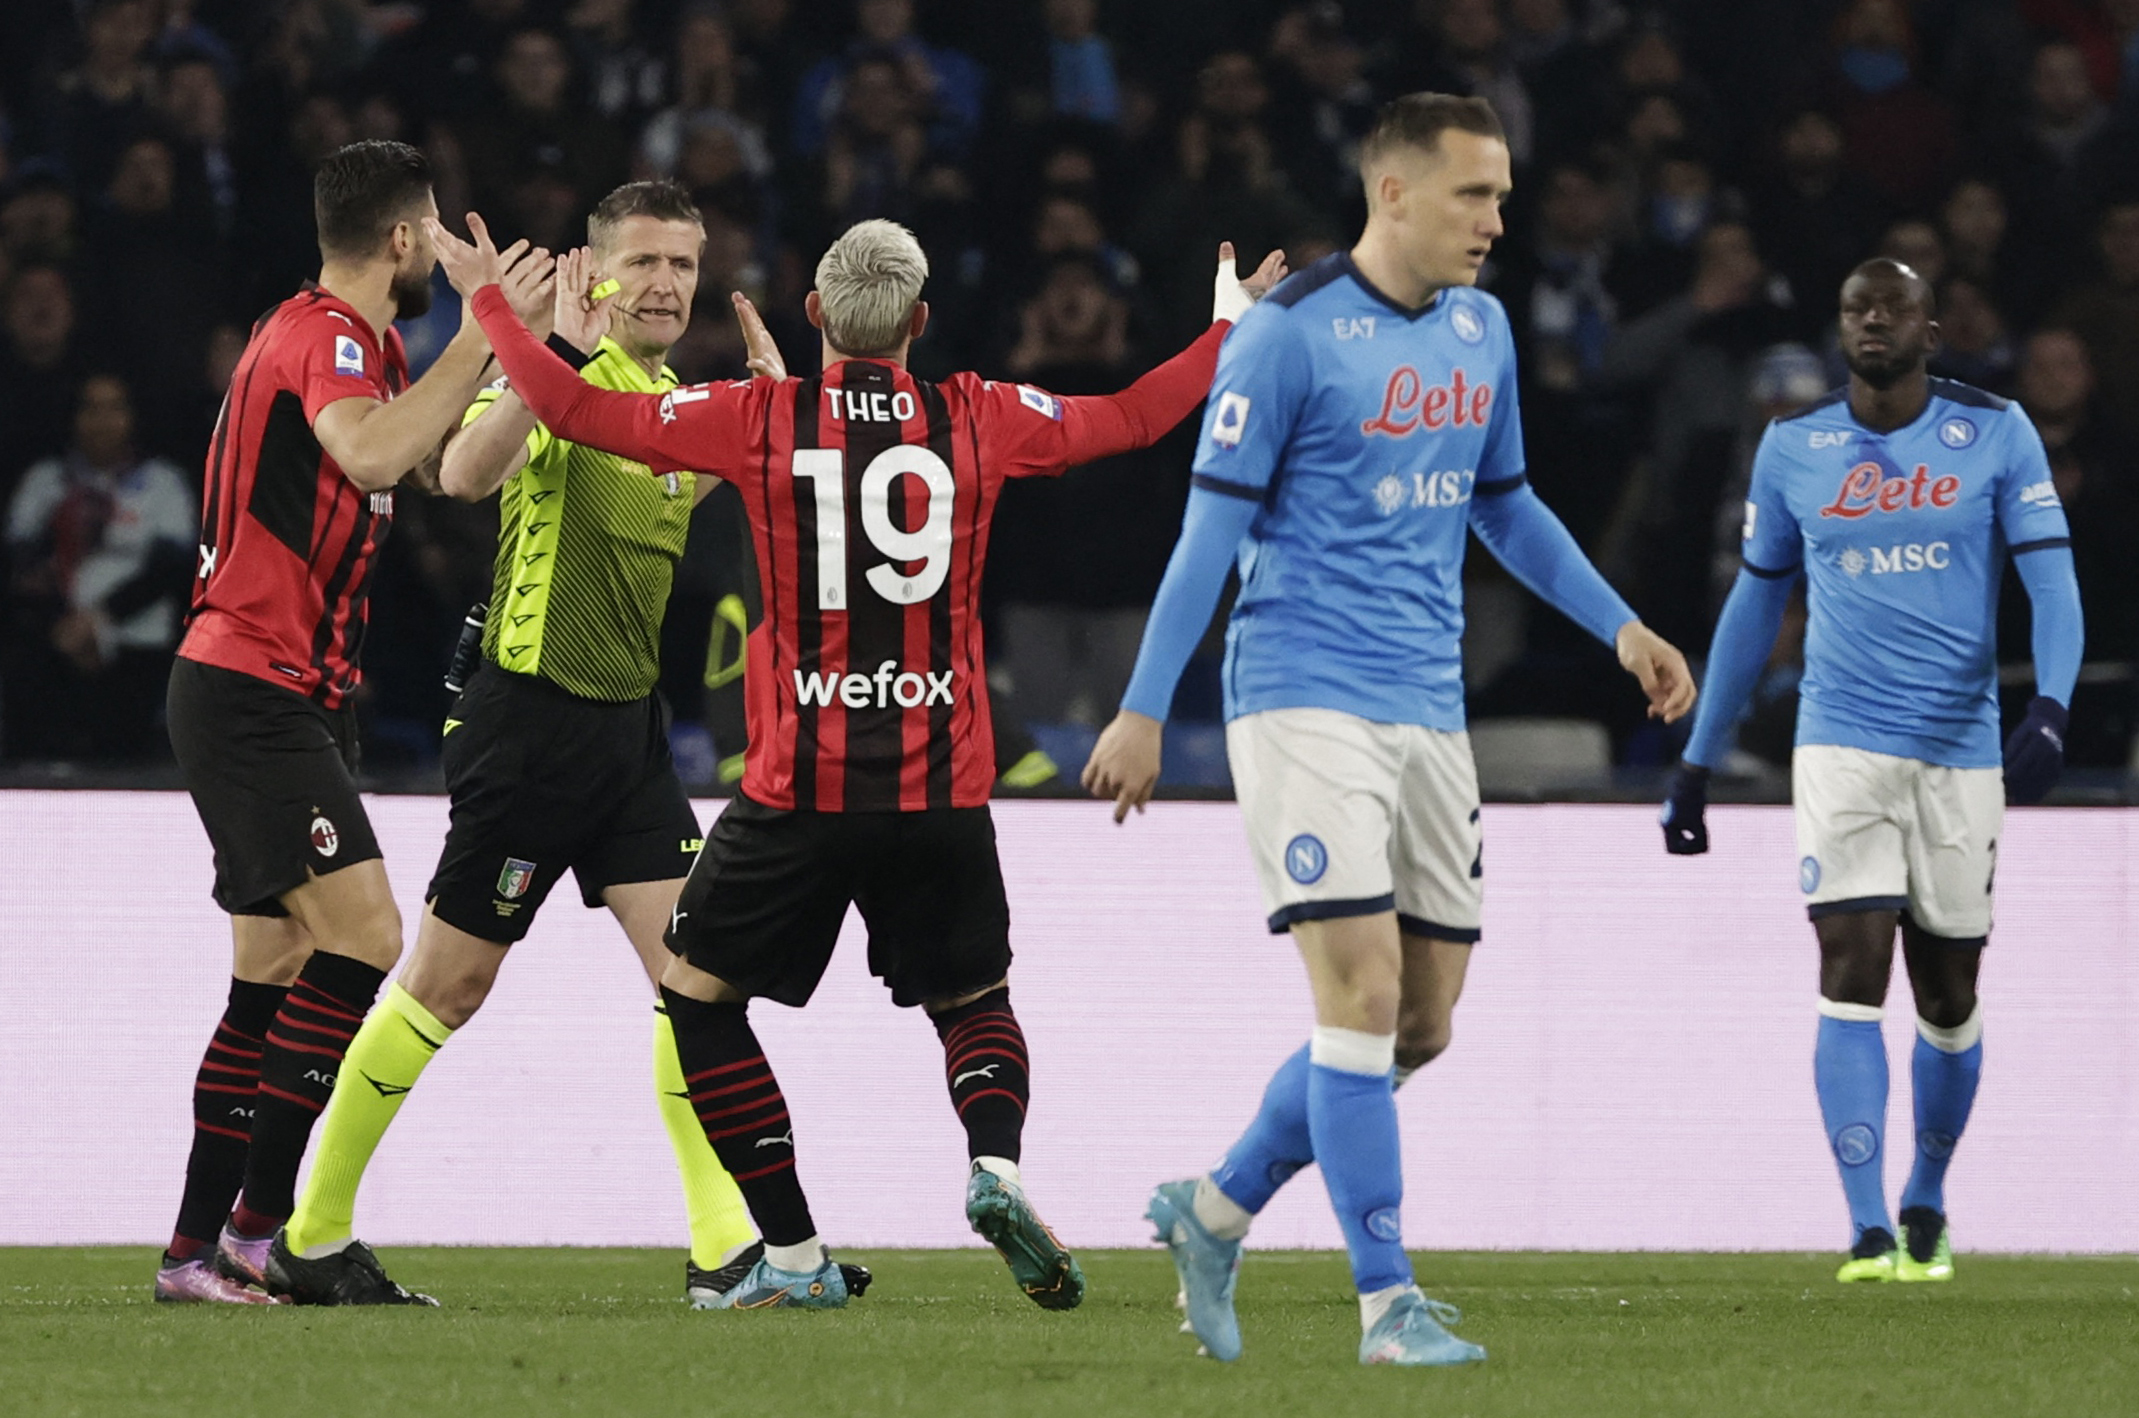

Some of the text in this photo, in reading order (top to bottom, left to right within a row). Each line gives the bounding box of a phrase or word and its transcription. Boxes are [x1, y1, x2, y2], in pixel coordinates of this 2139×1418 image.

[1332, 316, 1375, 340] EA7
[825, 387, 916, 422] THEO
[1361, 364, 1492, 439] Lete
[1808, 430, 1853, 449] EA7
[1819, 461, 1961, 520] Lete
[792, 443, 956, 611] 19
[1869, 540, 1950, 575] MSC
[792, 659, 955, 709] wefox
